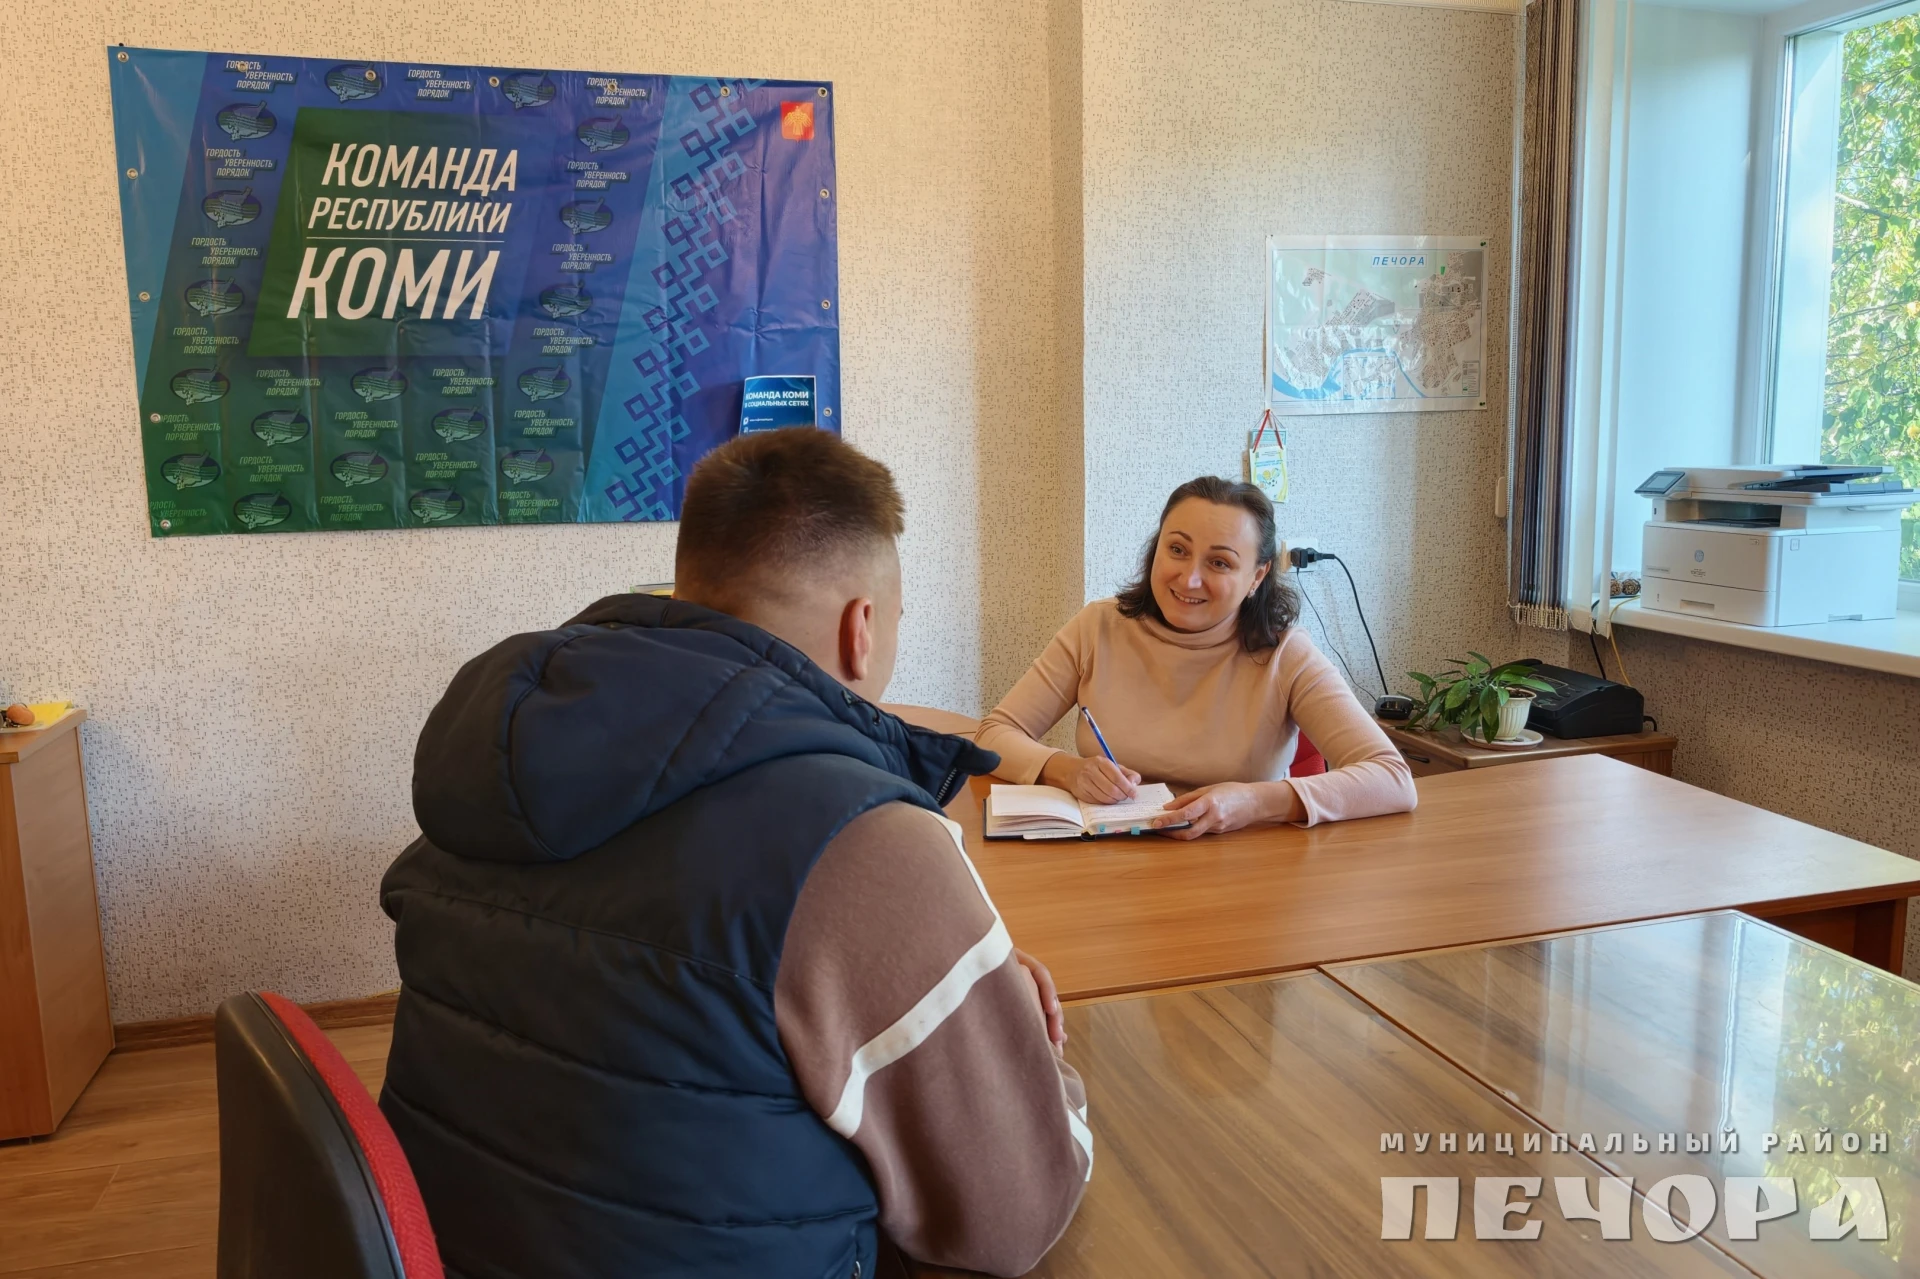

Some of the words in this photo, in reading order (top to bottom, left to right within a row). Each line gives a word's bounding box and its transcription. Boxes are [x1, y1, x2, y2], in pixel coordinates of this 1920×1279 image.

[245, 71, 294, 82] УВЕРЕННОСТЬ
[408, 69, 441, 79] ГОРДОСТЬ
[236, 80, 271, 90] ПОРЯДОК
[425, 79, 471, 90] УВЕРЕННОСТЬ
[417, 88, 450, 98] ПОРЯДОК
[595, 96, 627, 106] ПОРЯДОК
[206, 148, 241, 158] ГОРДОСТЬ
[224, 158, 273, 168] УВЕРЕННОСТЬ
[567, 161, 599, 170] ГОРДОСТЬ
[216, 167, 250, 177] ПОРЯДОК
[321, 143, 518, 196] КОМАНДА
[583, 170, 627, 180] УВЕРЕННОСТЬ
[576, 179, 606, 189] ПОРЯДОК
[308, 197, 512, 233] РЕСПУБЛИКИ
[191, 237, 226, 247] ГОРДОСТЬ
[210, 247, 258, 257] УВЕРЕННОСТЬ
[552, 243, 583, 253] ГОРДОСТЬ
[202, 256, 236, 266] ПОРЯДОК
[568, 253, 612, 262] УВЕРЕННОСТЬ
[1372, 256, 1425, 266] ПЕЧОРА
[560, 261, 591, 271] ПОРЯДОК
[286, 247, 500, 320] КОМИ
[173, 327, 207, 336] ГОРДОСТЬ
[533, 327, 564, 337] ГОРДОСТЬ
[192, 336, 239, 345] УВЕРЕННОСТЬ
[549, 336, 593, 346] УВЕРЕННОСТЬ
[184, 345, 217, 355] ПОРЯДОК
[542, 345, 572, 354] ПОРЯДОК
[256, 369, 290, 378] ГОРДОСТЬ
[432, 368, 465, 377] ГОРДОСТЬ
[274, 378, 321, 387] УВЕРЕННОСТЬ
[450, 377, 494, 386] УВЕРЕННОСТЬ
[266, 386, 299, 396] ПОРЯДОК
[442, 386, 474, 395] ПОРЯДОК
[745, 391, 780, 400] КОМАНДА
[782, 391, 809, 399] КОМИ
[334, 411, 368, 420] ГОРДОСТЬ
[514, 410, 545, 419] ГОРДОСТЬ
[352, 420, 398, 429] УВЕРЕННОСТЬ
[530, 418, 574, 427] УВЕРЕННОСТЬ
[173, 423, 220, 432] УВЕРЕННОСТЬ
[523, 426, 554, 435] ПОРЯДОК
[165, 432, 198, 441] ПОРЯДОК
[344, 429, 376, 438] ПОРЯДОК
[239, 456, 273, 465] ГОРДОСТЬ
[415, 452, 448, 461] ГОРДОСТЬ
[257, 464, 304, 473] УВЕРЕННОСТЬ
[432, 460, 477, 469] УВЕРЕННОСТЬ
[249, 473, 282, 482] ПОРЯДОК
[425, 469, 456, 478] ПОРЯДОК
[499, 491, 530, 500] ГОРДОСТЬ
[508, 507, 539, 516] ПОРЯДОК
